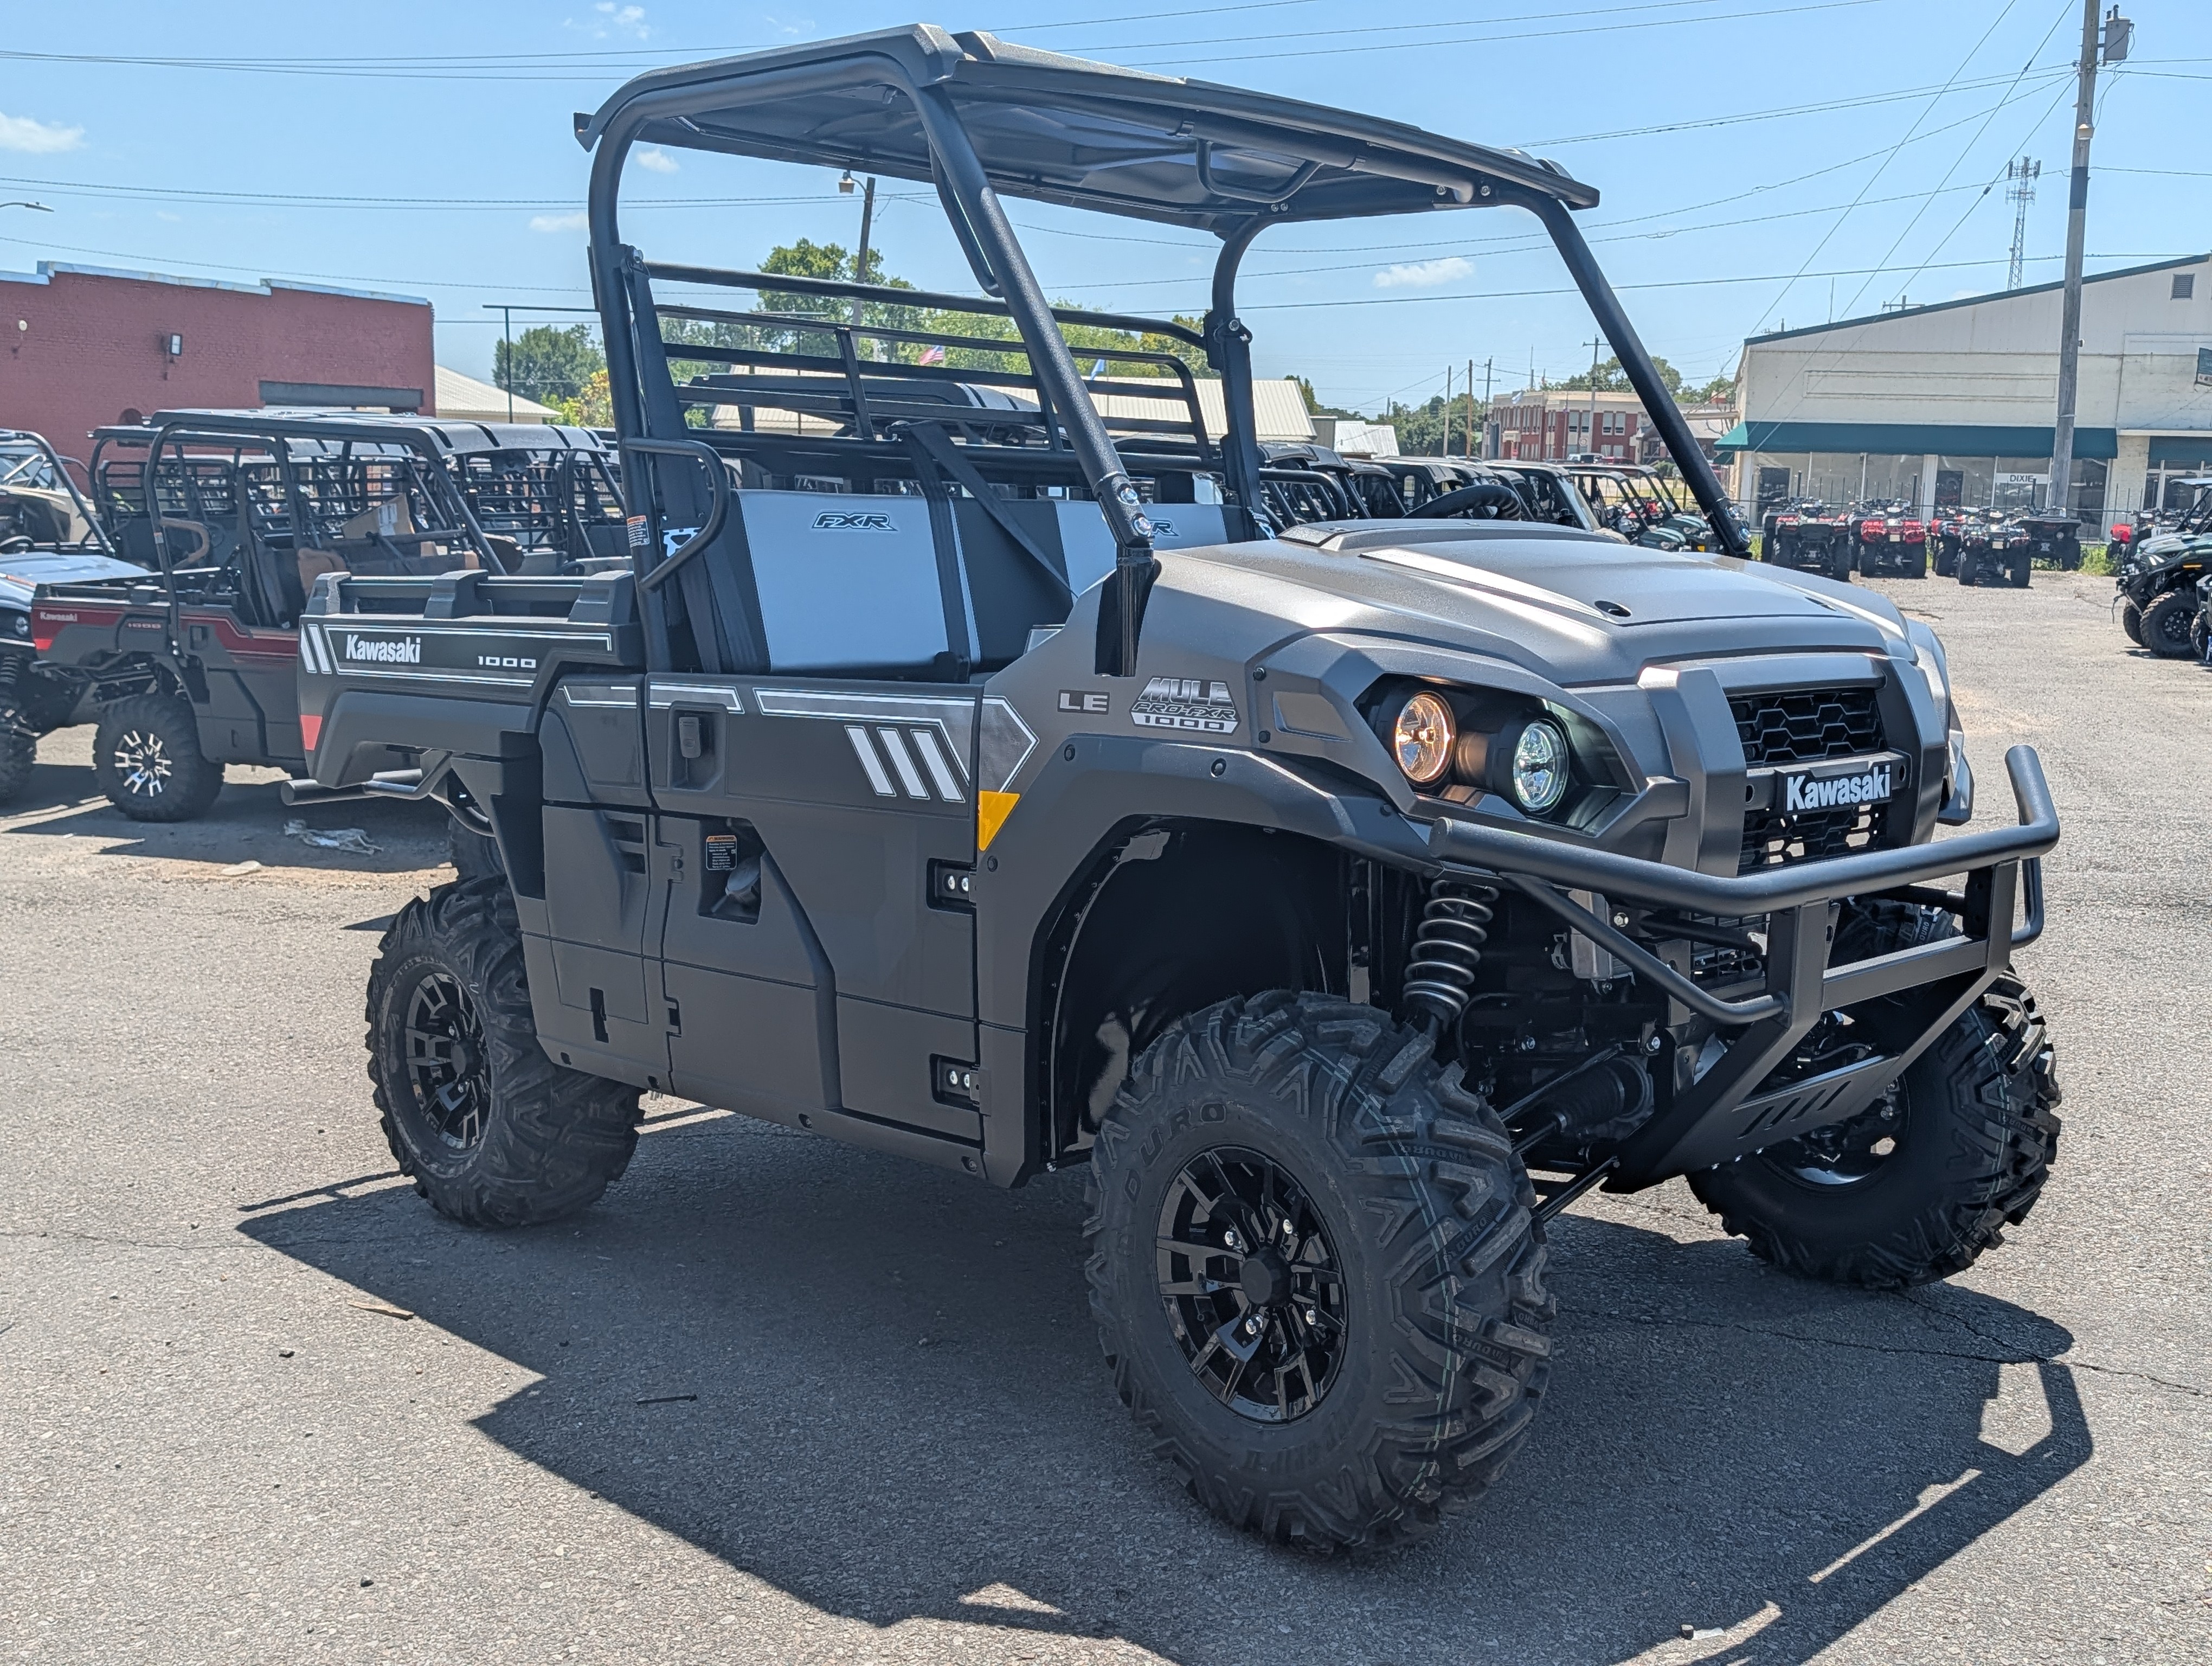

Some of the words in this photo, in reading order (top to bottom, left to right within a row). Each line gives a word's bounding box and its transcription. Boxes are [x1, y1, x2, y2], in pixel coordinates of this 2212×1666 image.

[812, 512, 898, 531] FXR
[40, 612, 78, 621] Kawasaki
[345, 635, 421, 663] Kawasaki
[478, 656, 536, 668] 1000
[1139, 678, 1234, 707] MULE
[1059, 693, 1108, 712] LE
[1131, 702, 1236, 720] PRO-FXR
[1143, 715, 1224, 731] 1000
[1787, 765, 1891, 811] Kawasaki
[1920, 921, 1930, 941] DURO
[1124, 1102, 1226, 1206] DURO
[1456, 1216, 1487, 1252] DURO
